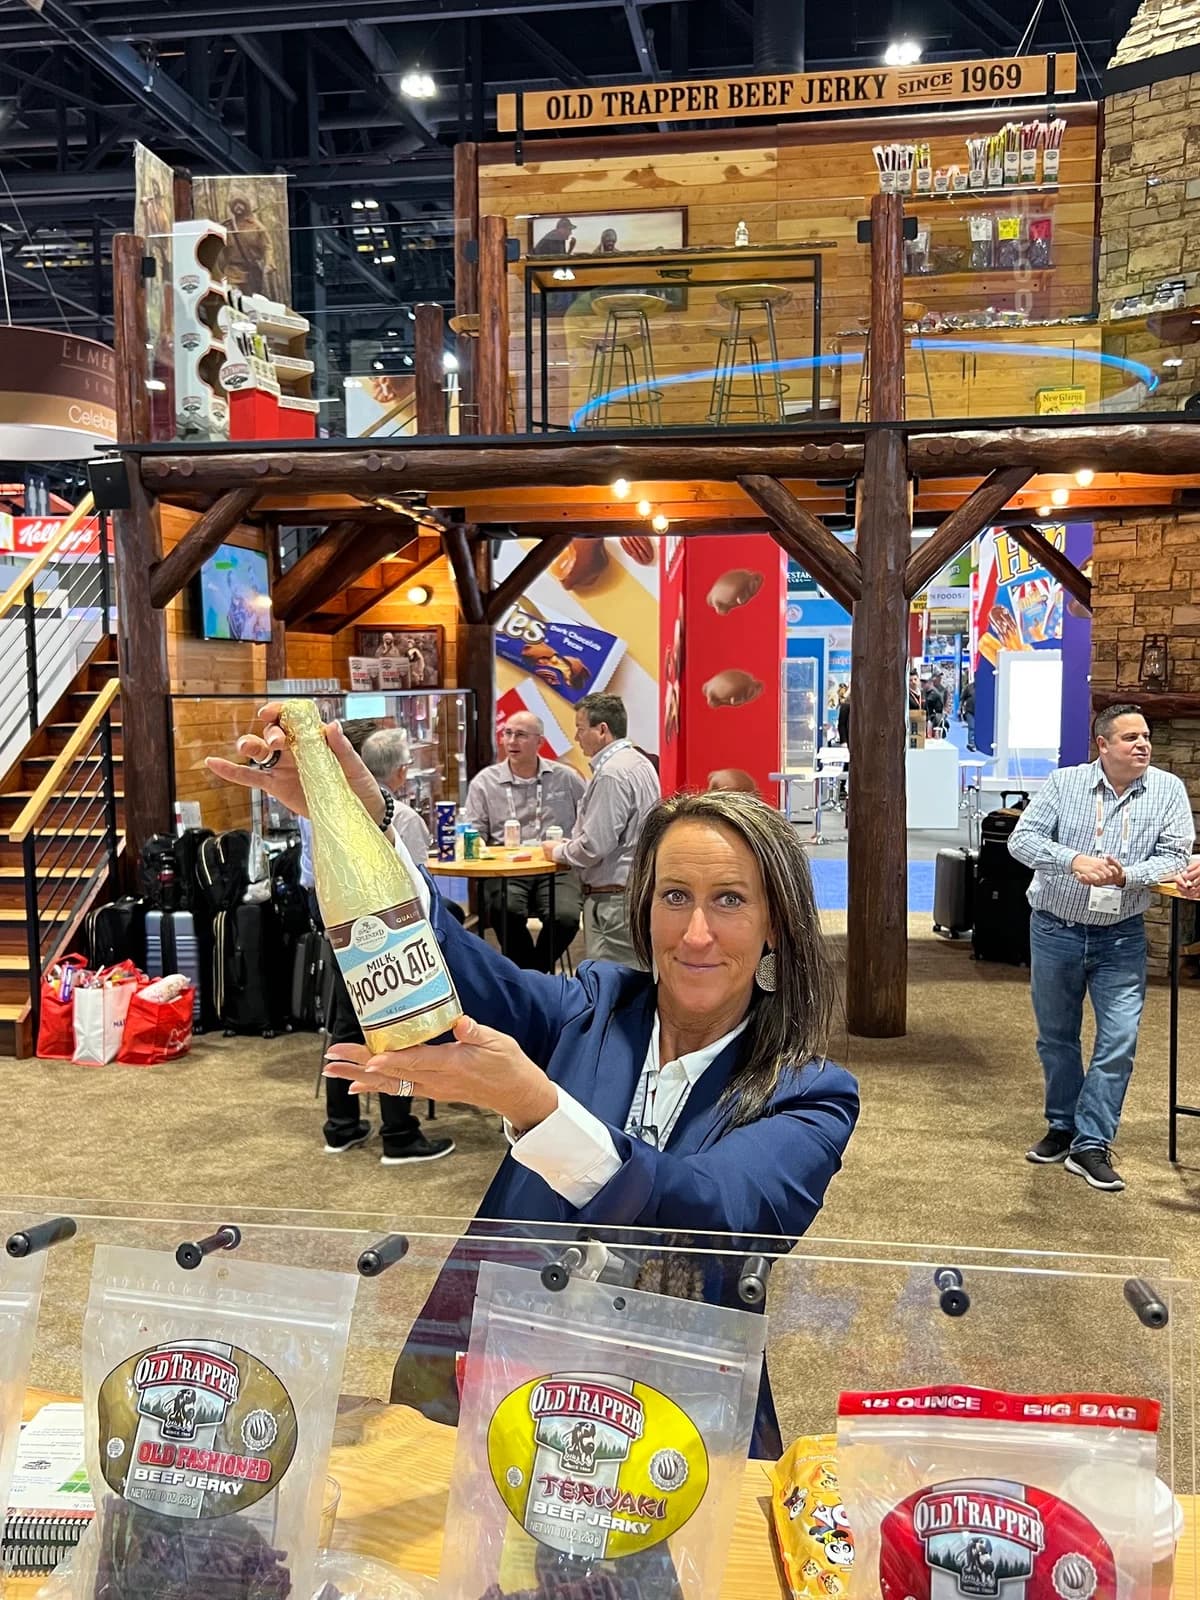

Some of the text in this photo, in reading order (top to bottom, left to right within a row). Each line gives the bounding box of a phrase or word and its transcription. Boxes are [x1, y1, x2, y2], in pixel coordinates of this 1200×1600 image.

[546, 63, 1022, 121] OLD TRAPPER BEEF JERKY SINCE 1969
[936, 592, 961, 600] FOODS
[549, 625, 602, 652] Dark Chocolate
[562, 637, 584, 652] Pecan
[366, 952, 397, 973] MILK
[136, 1353, 238, 1400] OLD TRAPPER
[531, 1385, 643, 1437] OLD TRAPPER
[896, 1395, 981, 1411] OUNCE
[1023, 1402, 1071, 1416] BIG
[1079, 1403, 1137, 1420] BAG
[136, 1441, 176, 1466] OLD
[176, 1447, 272, 1482] FASHIONED
[130, 1487, 144, 1498] NET
[134, 1468, 243, 1496] BEEF JERKY
[537, 1472, 667, 1520] TERIYAKI
[530, 1521, 543, 1532] NET
[533, 1501, 652, 1535] BEEF JERKY
[915, 1495, 1044, 1548] OLD TRAPPER
